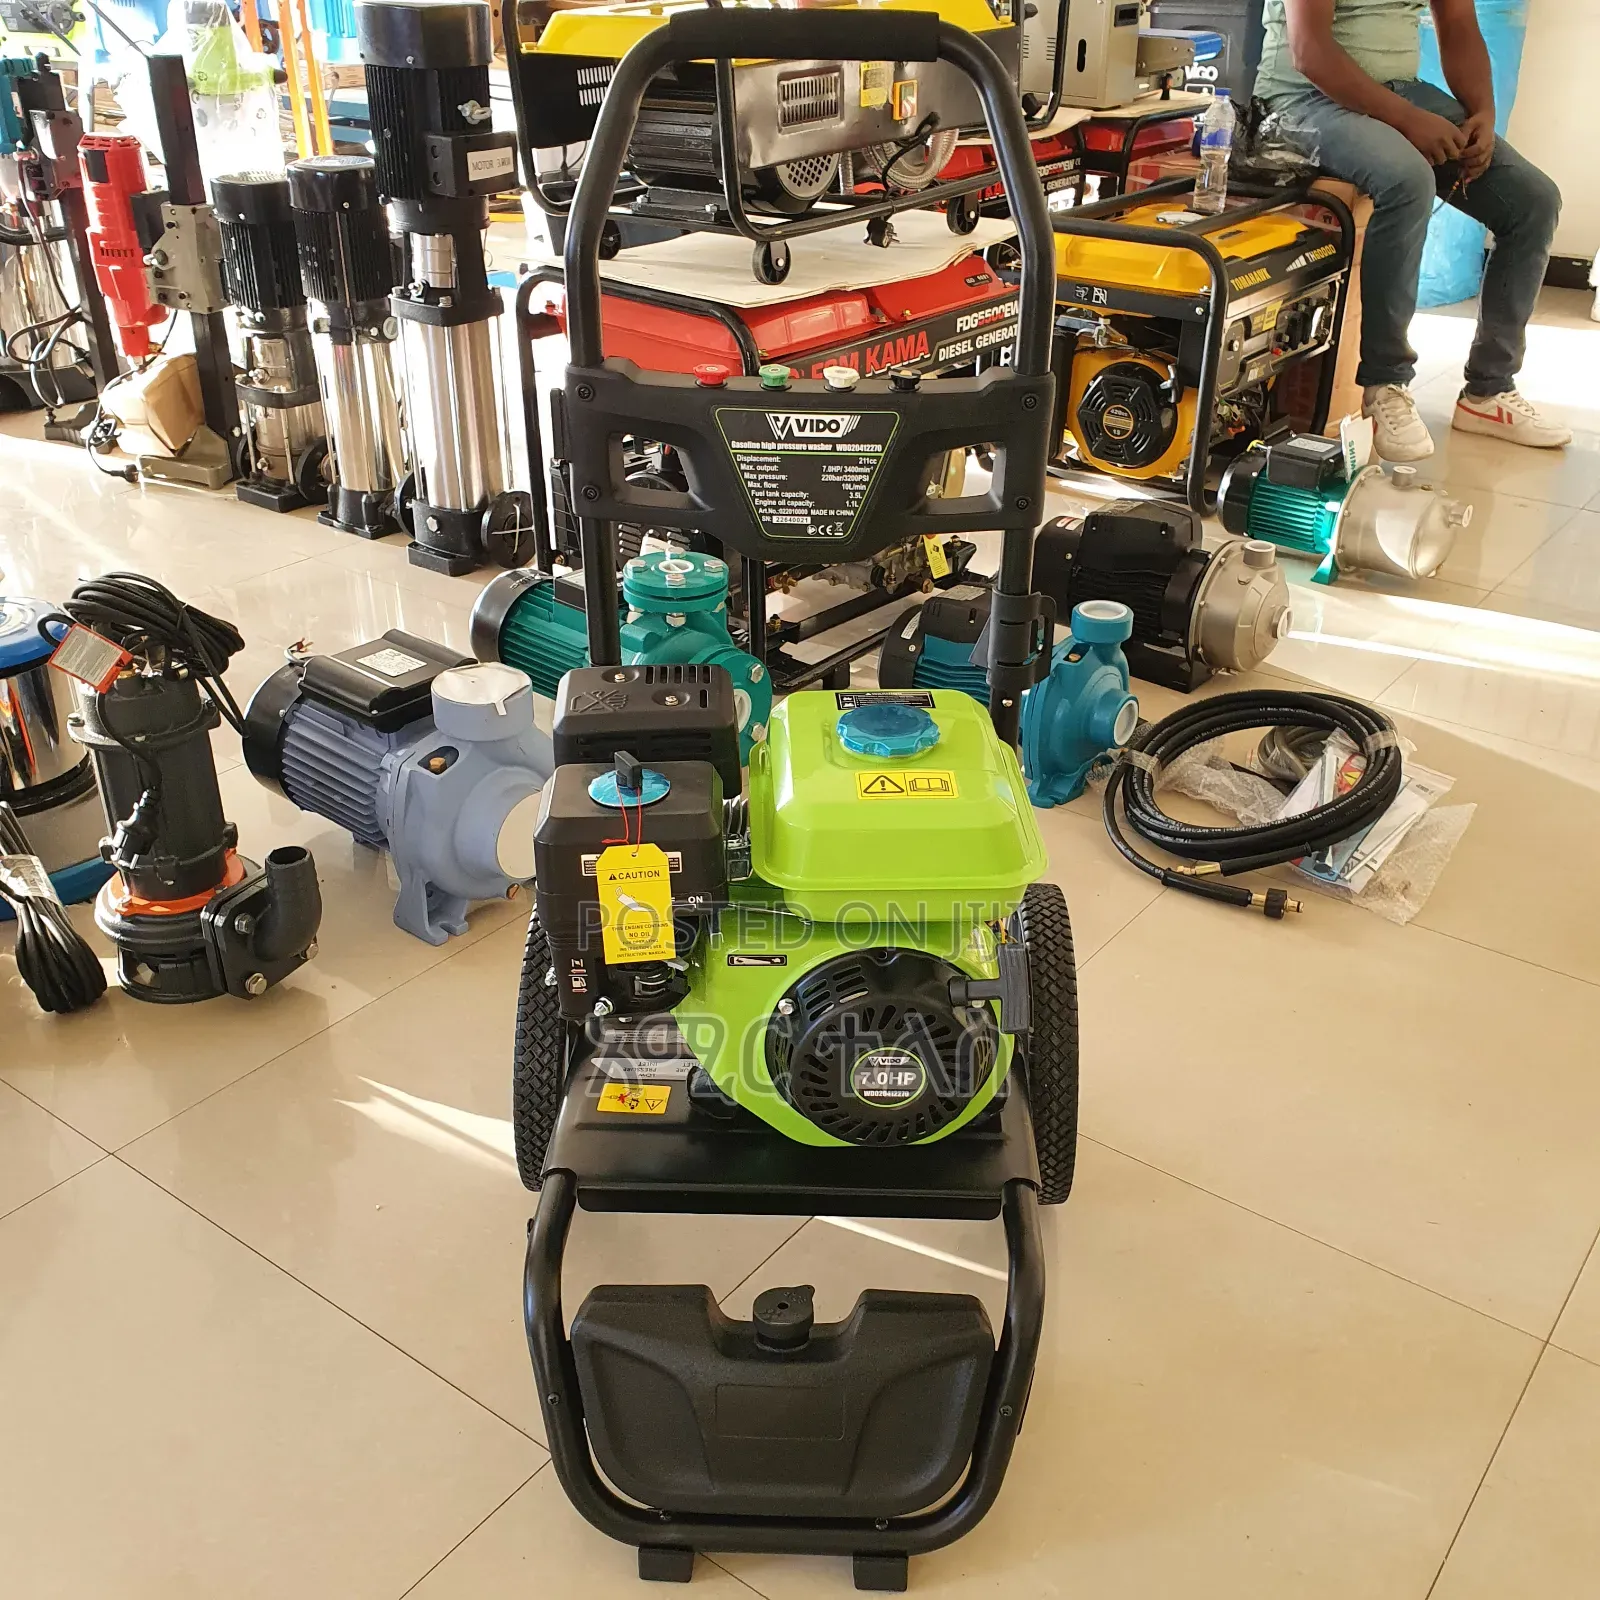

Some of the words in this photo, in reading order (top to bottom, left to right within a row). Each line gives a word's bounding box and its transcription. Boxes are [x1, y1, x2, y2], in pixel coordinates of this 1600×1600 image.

[472, 160, 495, 171] MOTOR
[1046, 174, 1080, 191] GENERATOR
[1230, 267, 1272, 291] TOMAHAWK
[939, 339, 974, 362] DIESEL
[975, 323, 1019, 349] GENERAT
[865, 330, 930, 377] KAMA
[731, 440, 761, 450] Gasoline
[761, 441, 777, 451] high
[777, 442, 807, 452] pressure
[807, 443, 832, 451] washer
[736, 454, 781, 464] Displacement:
[858, 457, 877, 465] 211cc
[740, 463, 756, 471] Max.
[756, 464, 779, 472] output:
[763, 481, 779, 489] flow:
[842, 483, 866, 491] 10L/min
[766, 490, 780, 498] tank
[781, 491, 809, 499] capacity:
[754, 499, 777, 507] Engine
[787, 500, 815, 508] capacity:
[618, 870, 661, 880] CAUTION
[687, 895, 703, 904] ON
[860, 1071, 917, 1086] 7.0HP
